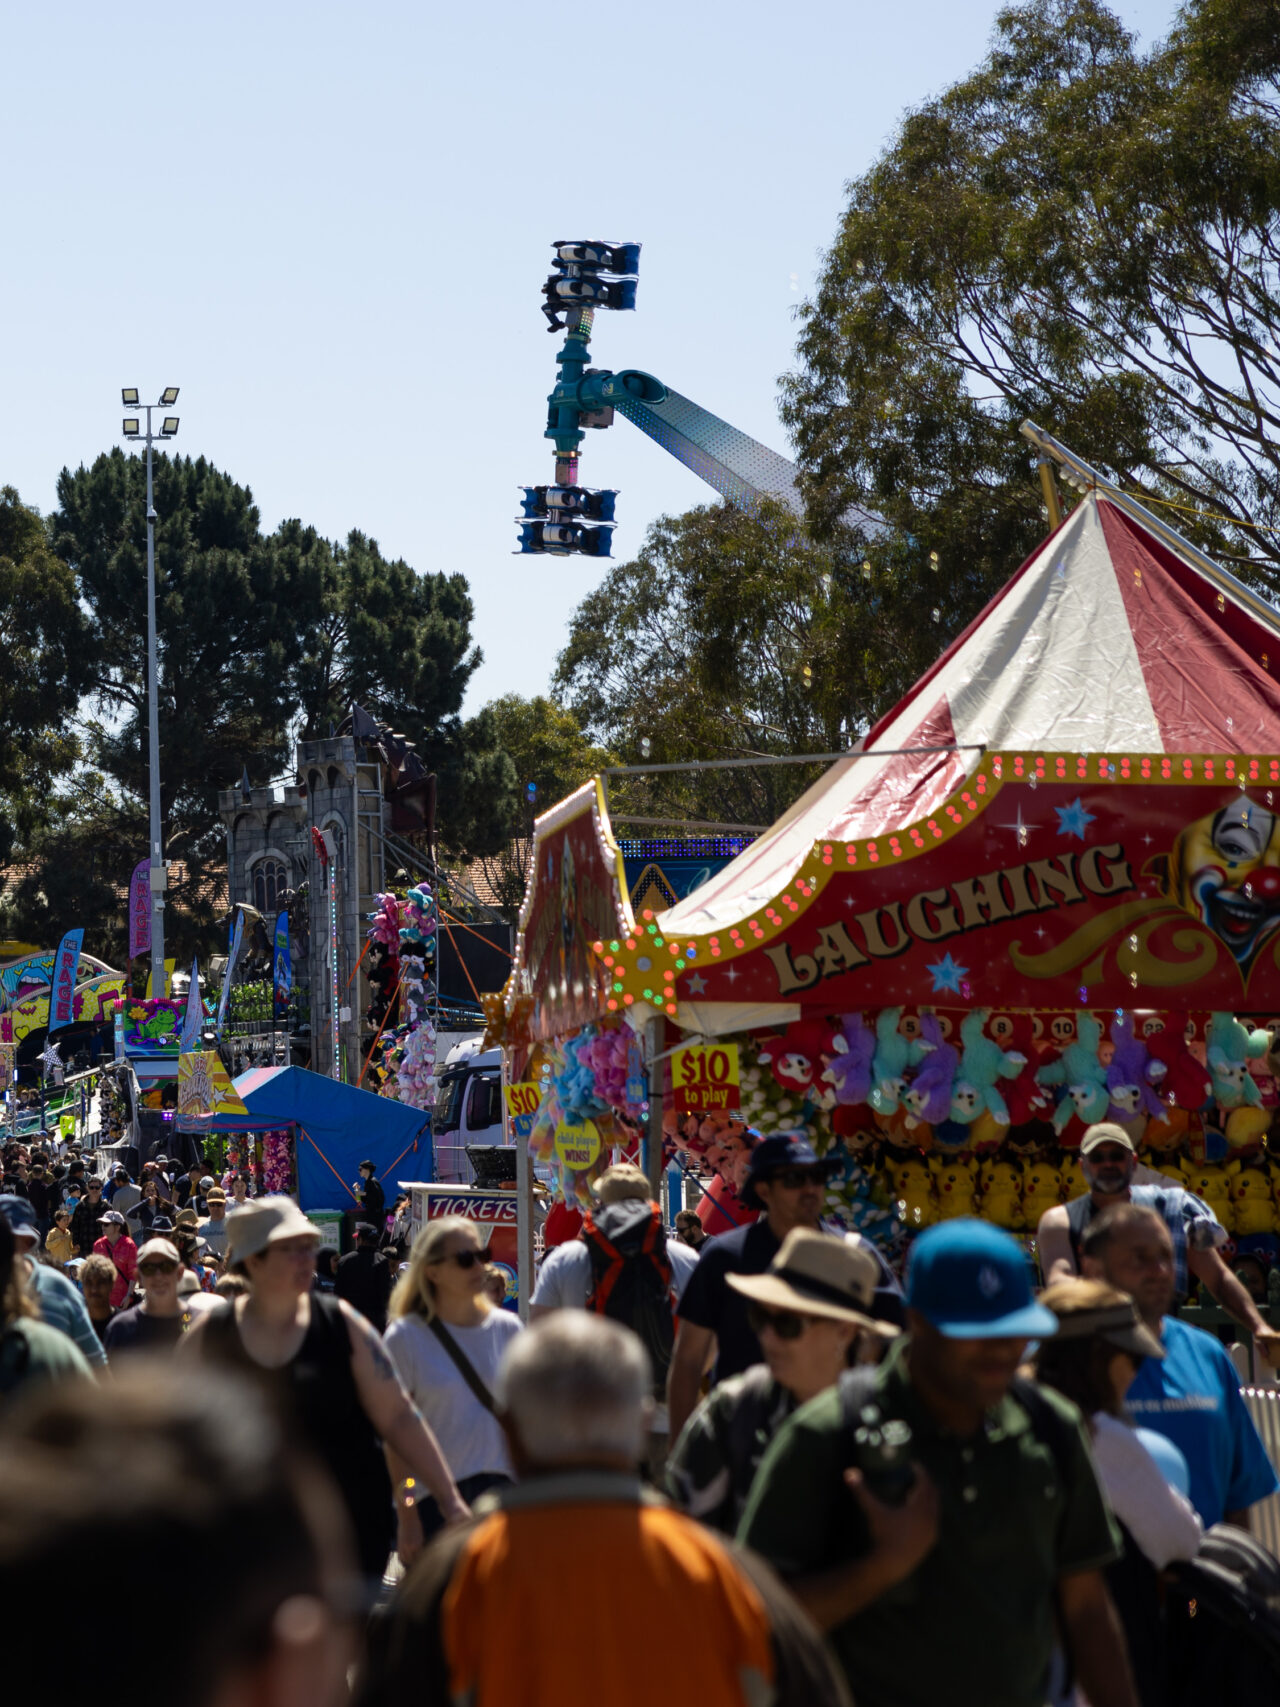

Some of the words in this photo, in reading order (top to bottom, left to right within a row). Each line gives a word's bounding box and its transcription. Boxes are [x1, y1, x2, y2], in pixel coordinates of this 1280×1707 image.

[134, 882, 149, 949] RAGE
[763, 842, 1137, 996] LAUGHING
[55, 951, 74, 1021] RAGE
[997, 1022, 1007, 1033] 8
[1053, 1023, 1073, 1033] 10
[681, 1049, 730, 1084] $10
[510, 1086, 540, 1115] $10
[685, 1087, 698, 1104] to
[702, 1085, 728, 1109] play
[432, 1198, 518, 1220] TICKETS
